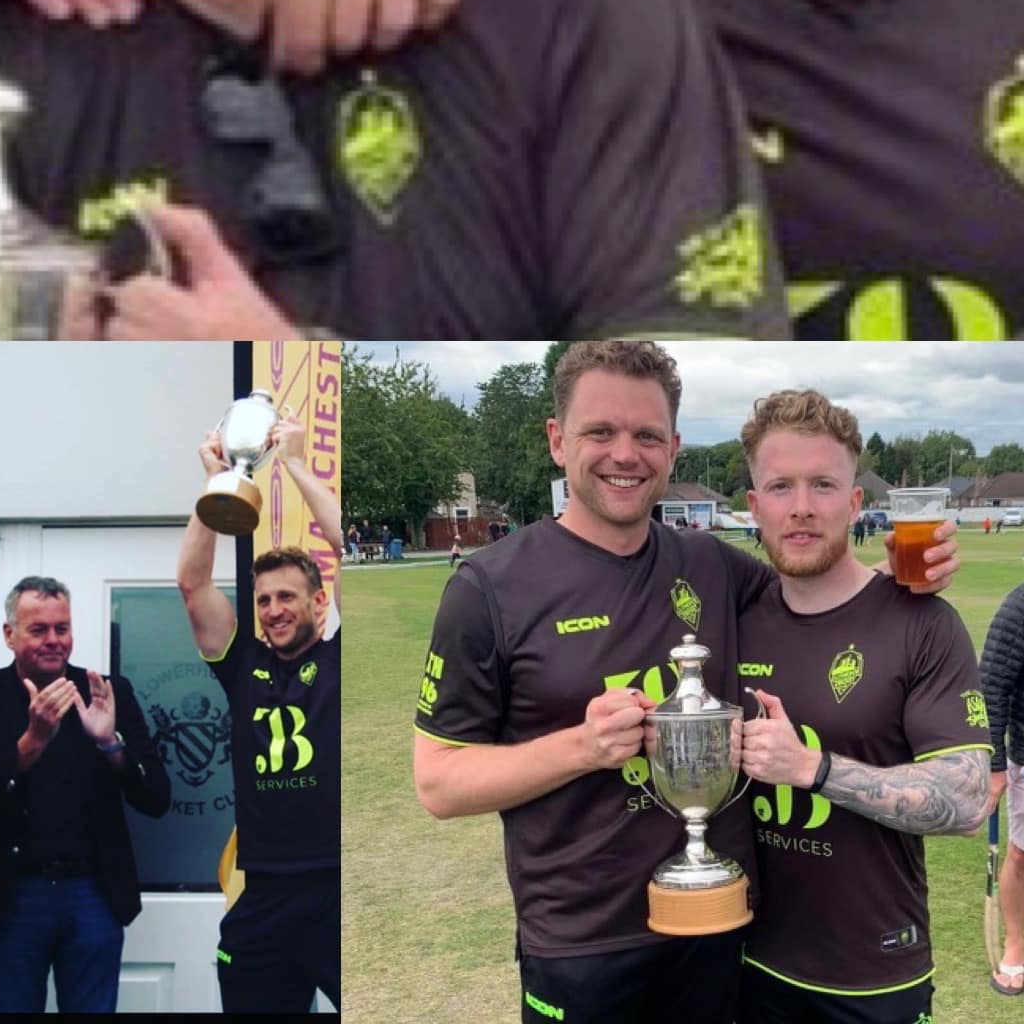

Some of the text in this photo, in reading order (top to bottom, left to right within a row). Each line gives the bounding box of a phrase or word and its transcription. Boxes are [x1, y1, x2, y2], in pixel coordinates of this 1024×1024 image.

[556, 616, 611, 634] ICON
[256, 776, 317, 791] SERVICES
[756, 828, 833, 857] SERVICES
